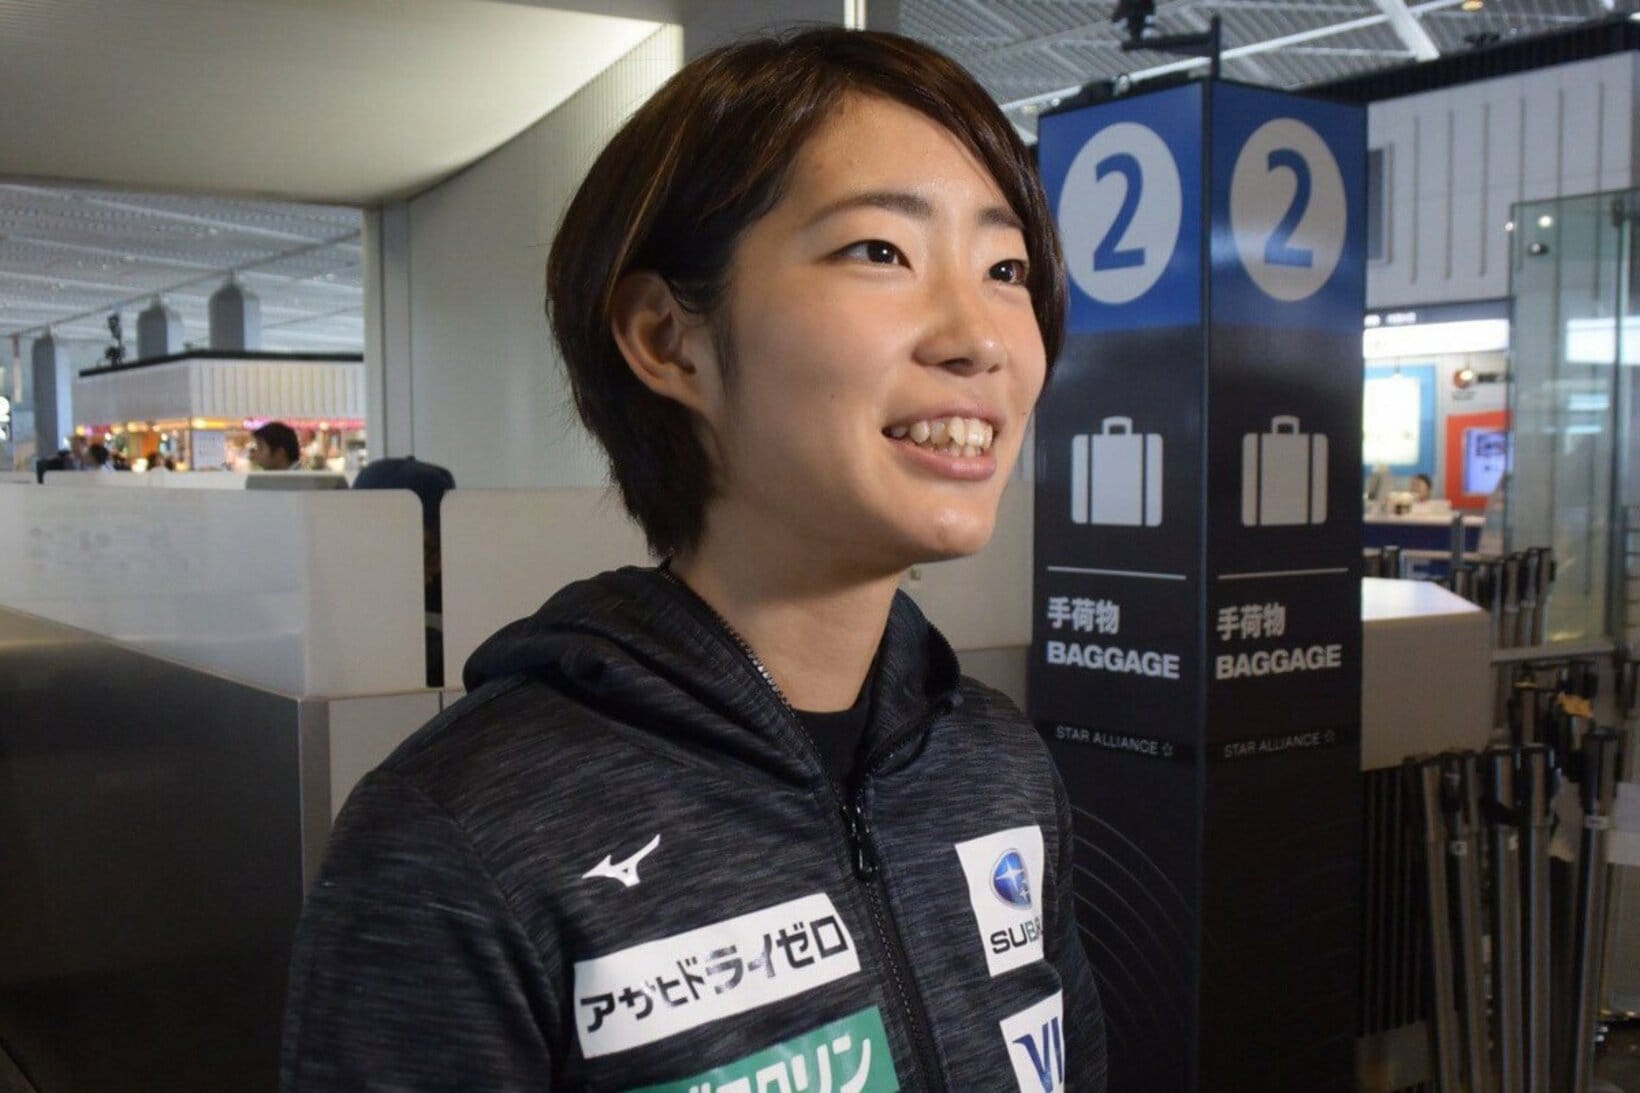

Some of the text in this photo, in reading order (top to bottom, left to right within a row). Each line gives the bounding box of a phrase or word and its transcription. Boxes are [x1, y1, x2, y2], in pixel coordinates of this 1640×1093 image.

[1093, 152, 1146, 271] 2
[1263, 147, 1314, 268] 2
[1047, 596, 1120, 635] 手荷物
[1216, 602, 1286, 641] 手荷物
[1046, 640, 1181, 679] BAGGAGE
[1215, 644, 1342, 680] BAGGAGE
[1055, 725, 1158, 755] STAR ALLIANCE
[1223, 731, 1321, 758] STAR ALLIANCE
[580, 915, 849, 1033] アサヒドライゼロ
